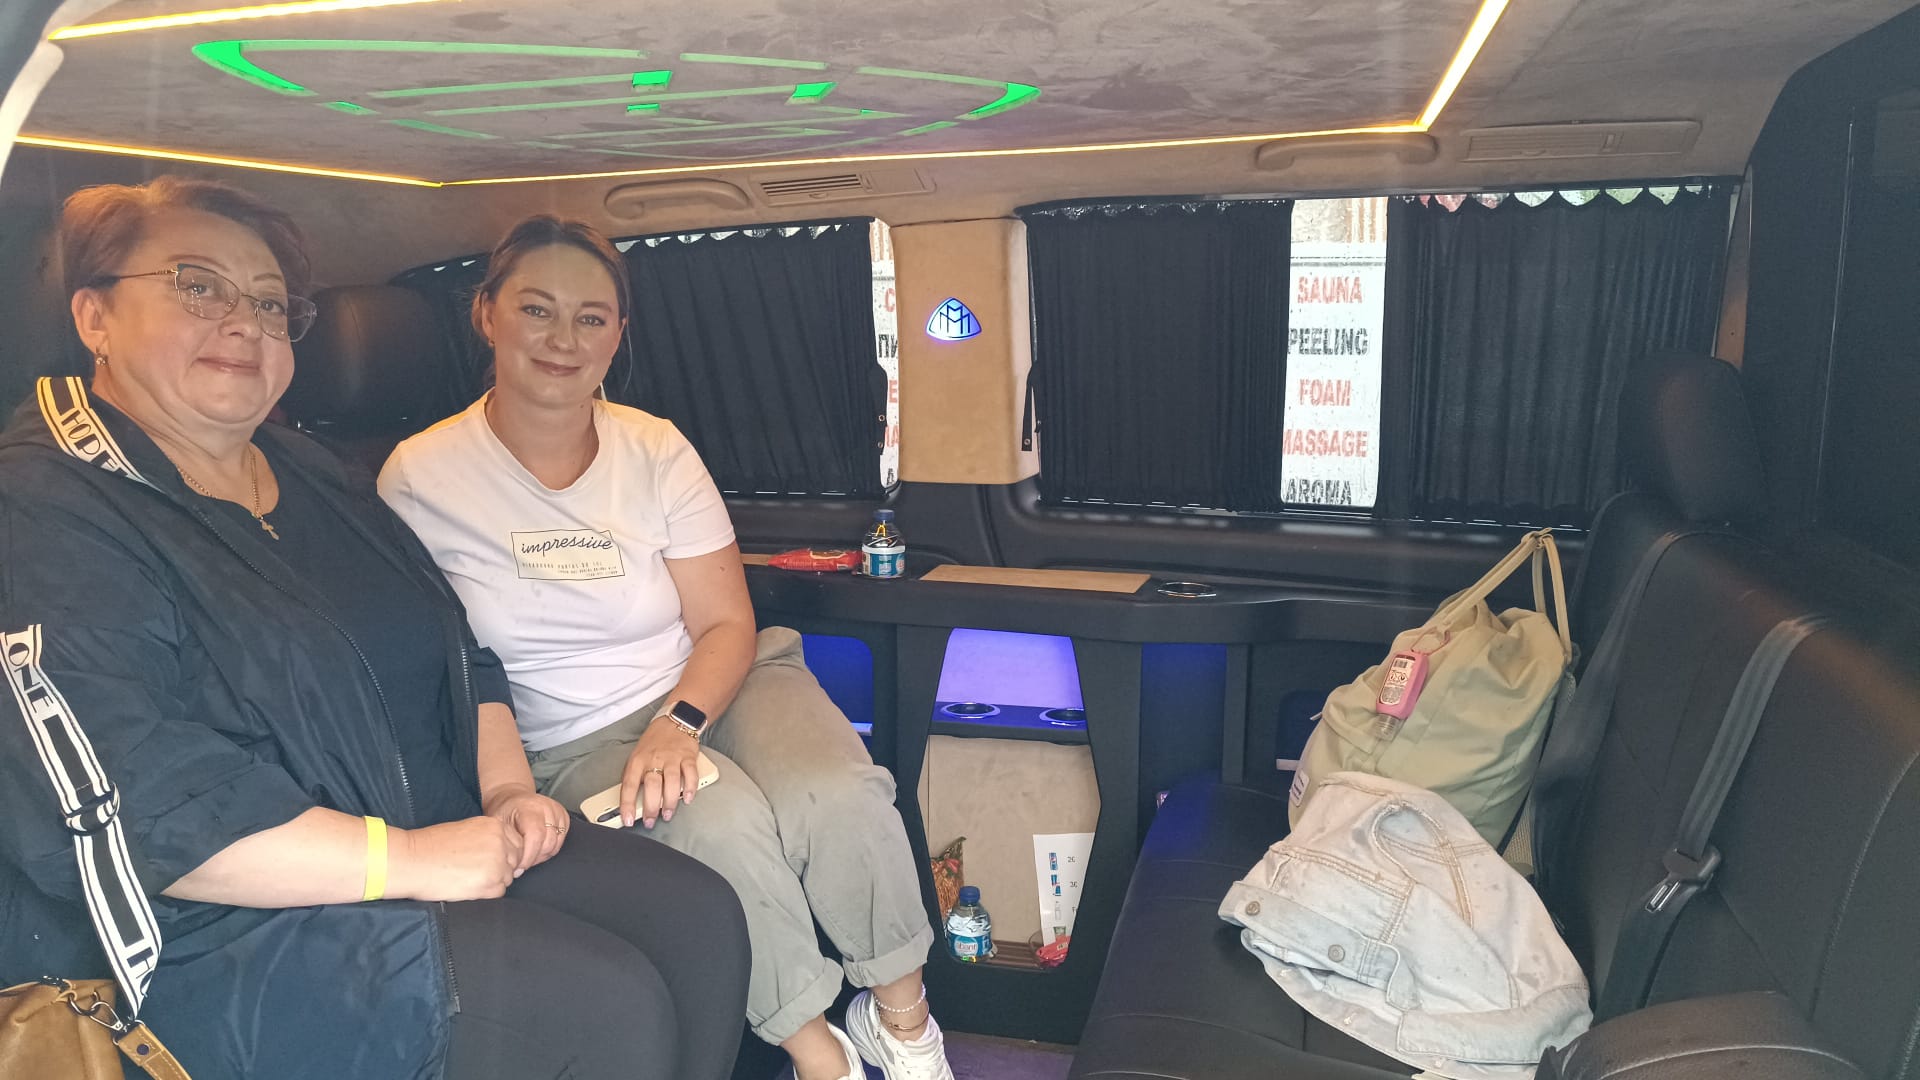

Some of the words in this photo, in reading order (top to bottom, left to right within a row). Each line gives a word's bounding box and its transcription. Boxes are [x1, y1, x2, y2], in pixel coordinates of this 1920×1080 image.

[1297, 276, 1363, 304] SAUNA
[1287, 327, 1368, 355] PEELING
[1298, 379, 1351, 407] FOAM
[1285, 479, 1352, 504] AROMA
[521, 536, 613, 557] impressive
